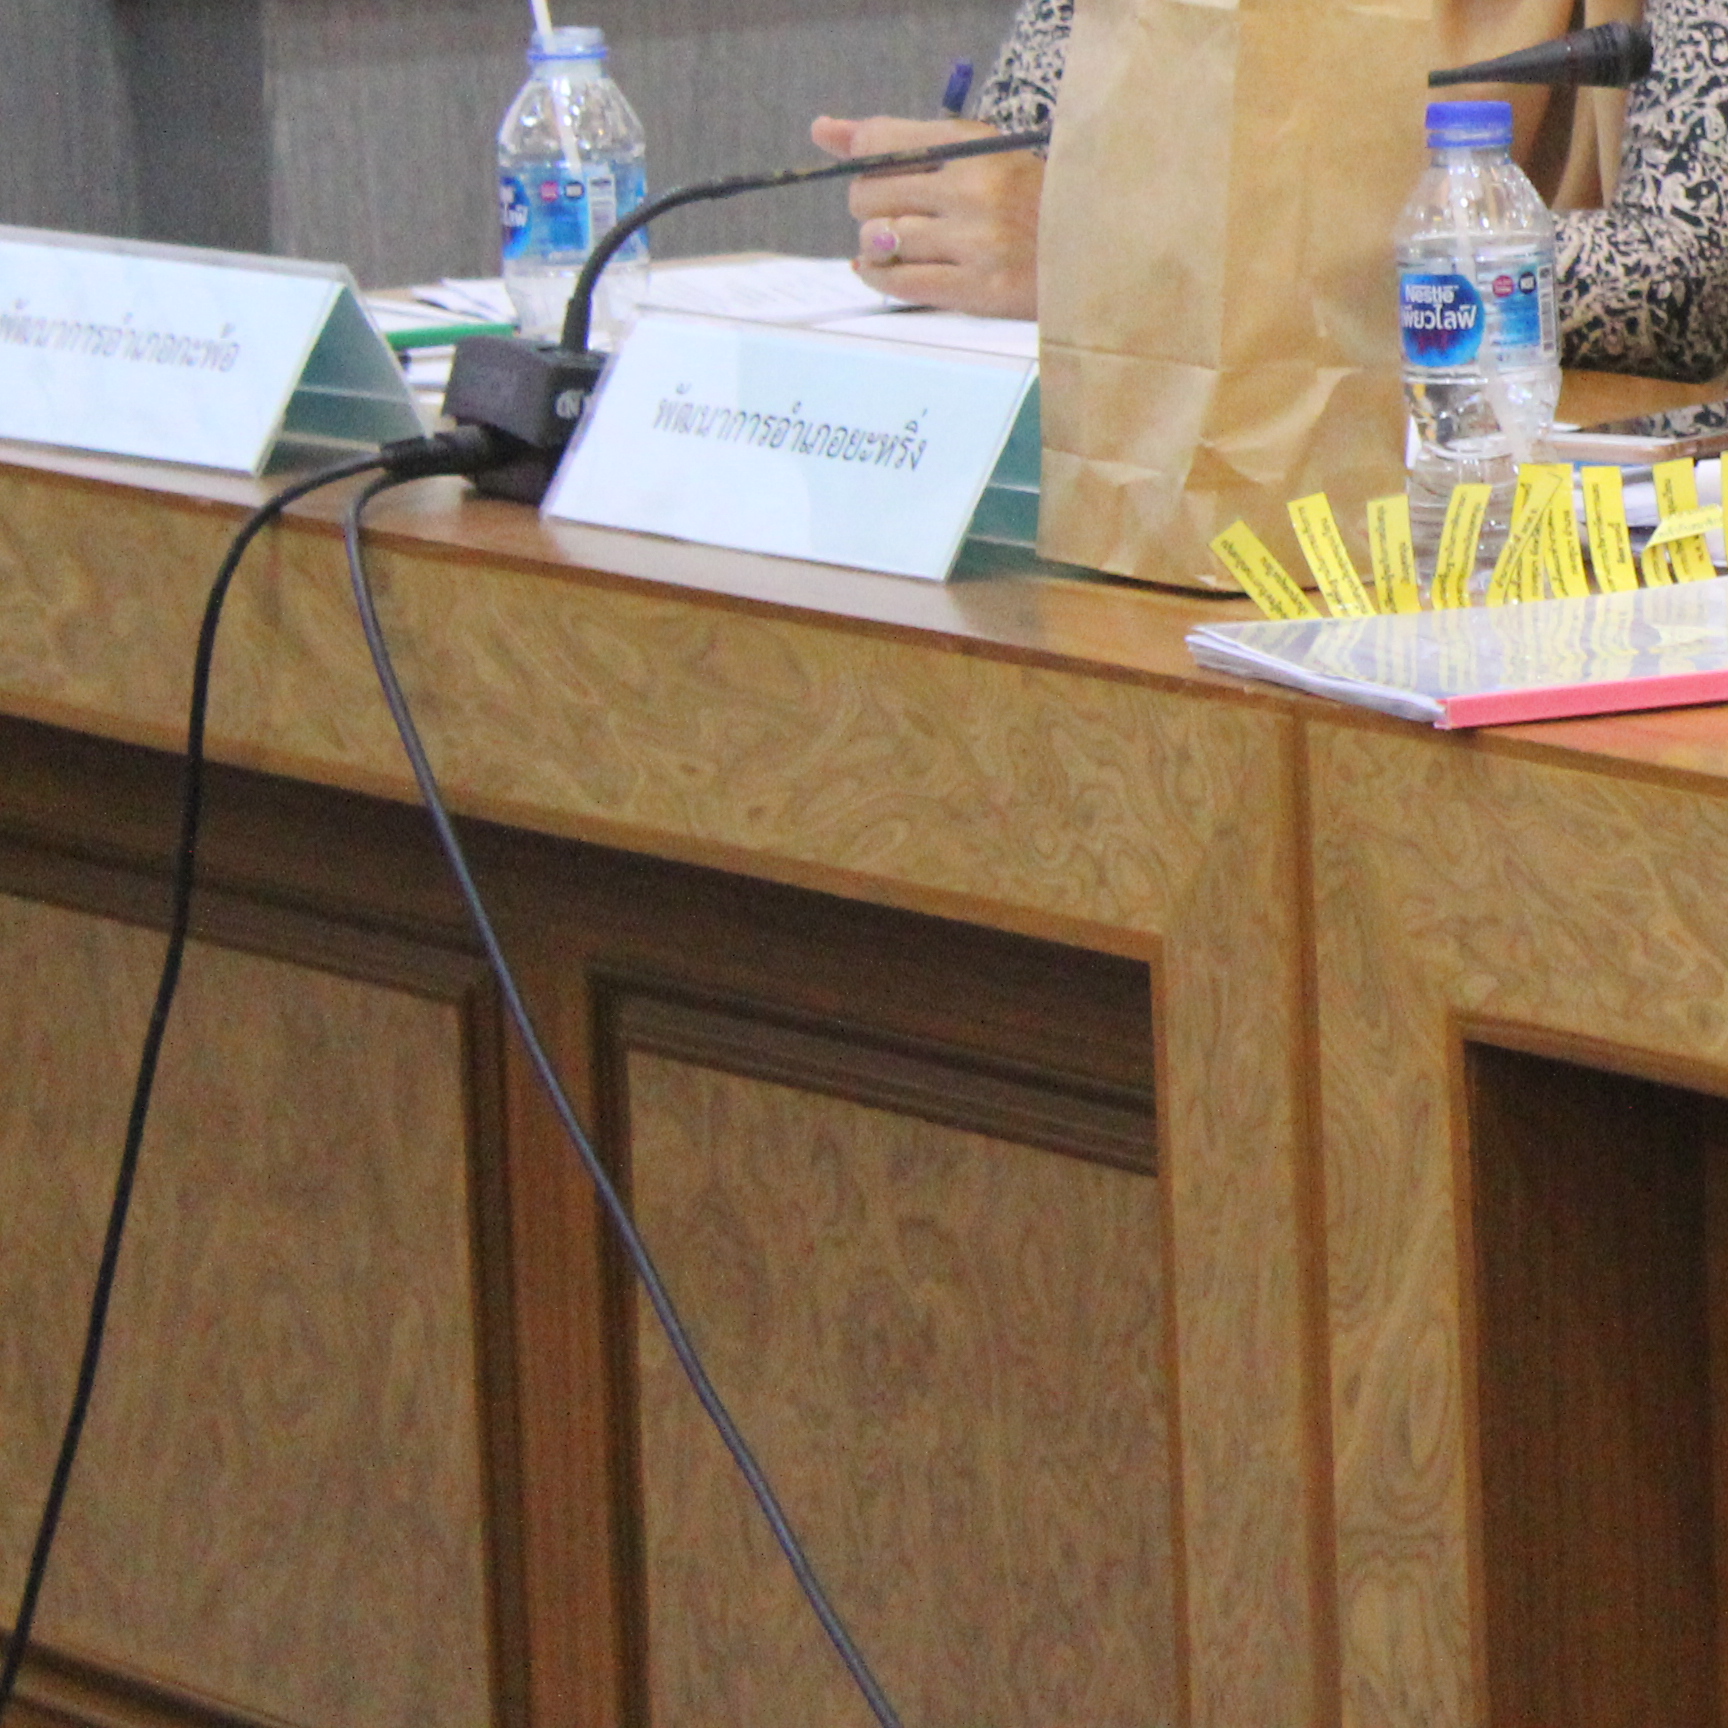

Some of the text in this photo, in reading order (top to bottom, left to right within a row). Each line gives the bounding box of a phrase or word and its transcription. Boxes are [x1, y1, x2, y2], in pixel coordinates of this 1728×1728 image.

[652, 382, 928, 472] พัฒนาการอำเภอยะหริ่ง
